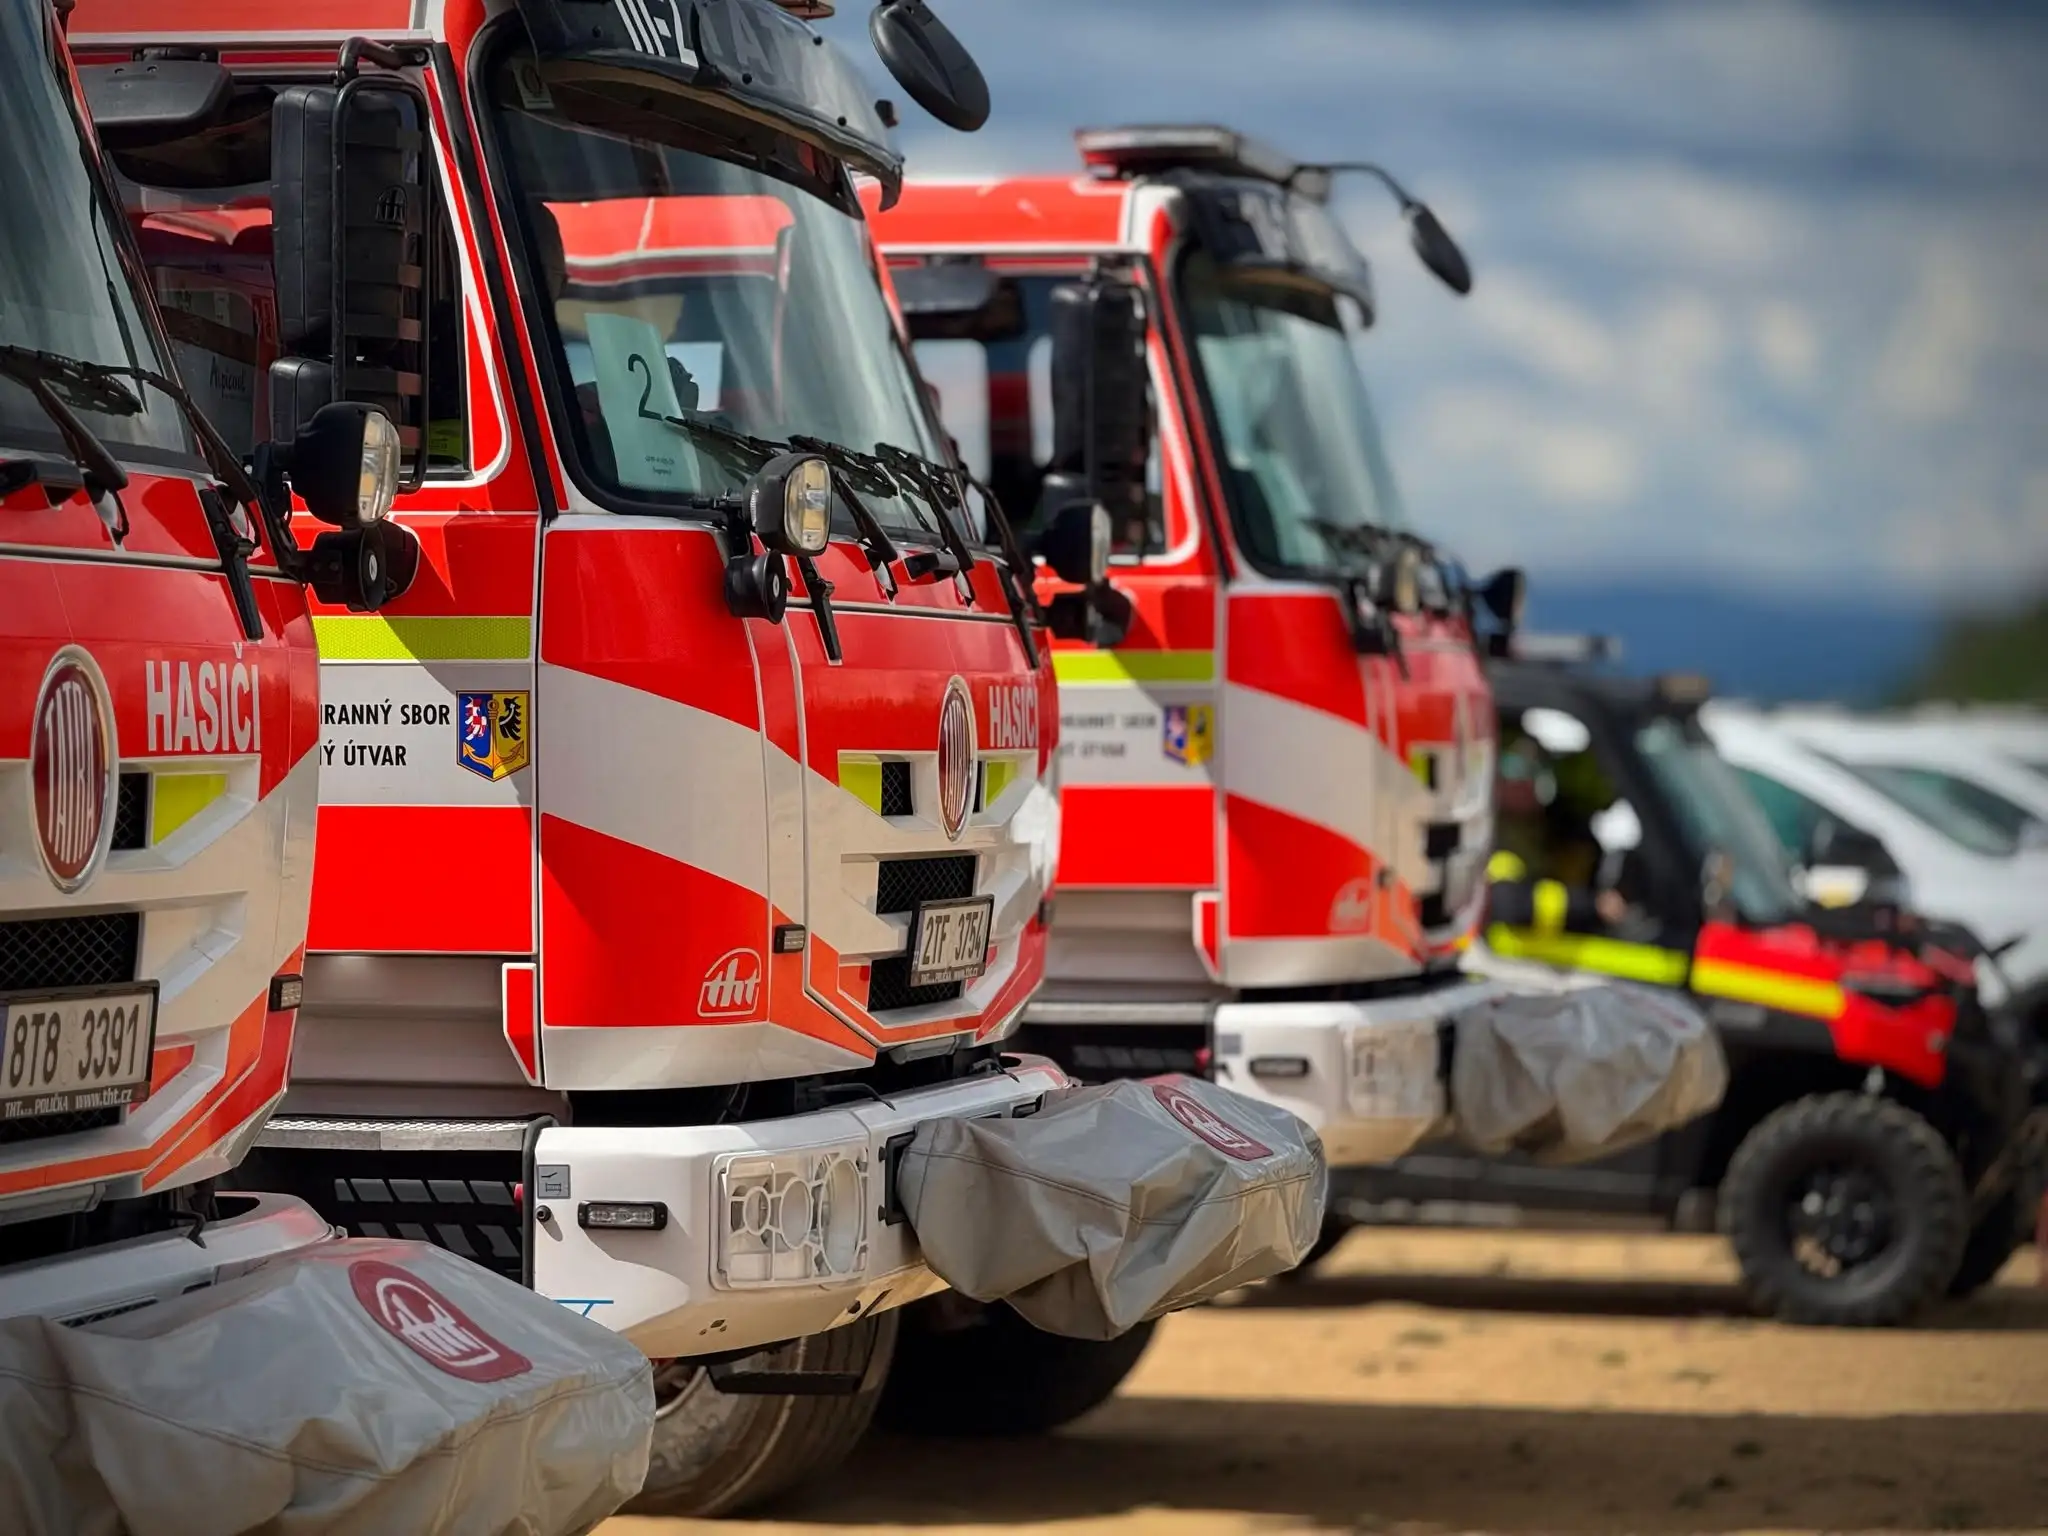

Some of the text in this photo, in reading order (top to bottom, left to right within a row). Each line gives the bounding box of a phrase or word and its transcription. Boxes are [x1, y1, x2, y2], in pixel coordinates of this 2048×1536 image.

[627, 353, 664, 421] 2
[145, 642, 261, 752] HASIČI
[320, 698, 450, 725] RANNÝ SBOR
[45, 681, 96, 865] TATRA
[320, 739, 407, 766] Ý ÚTVAR
[922, 910, 984, 965] 2TF 3754
[703, 957, 760, 1008] tht
[9, 1004, 140, 1088] 8T8 3391
[75, 1088, 133, 1109] www.tht.cz
